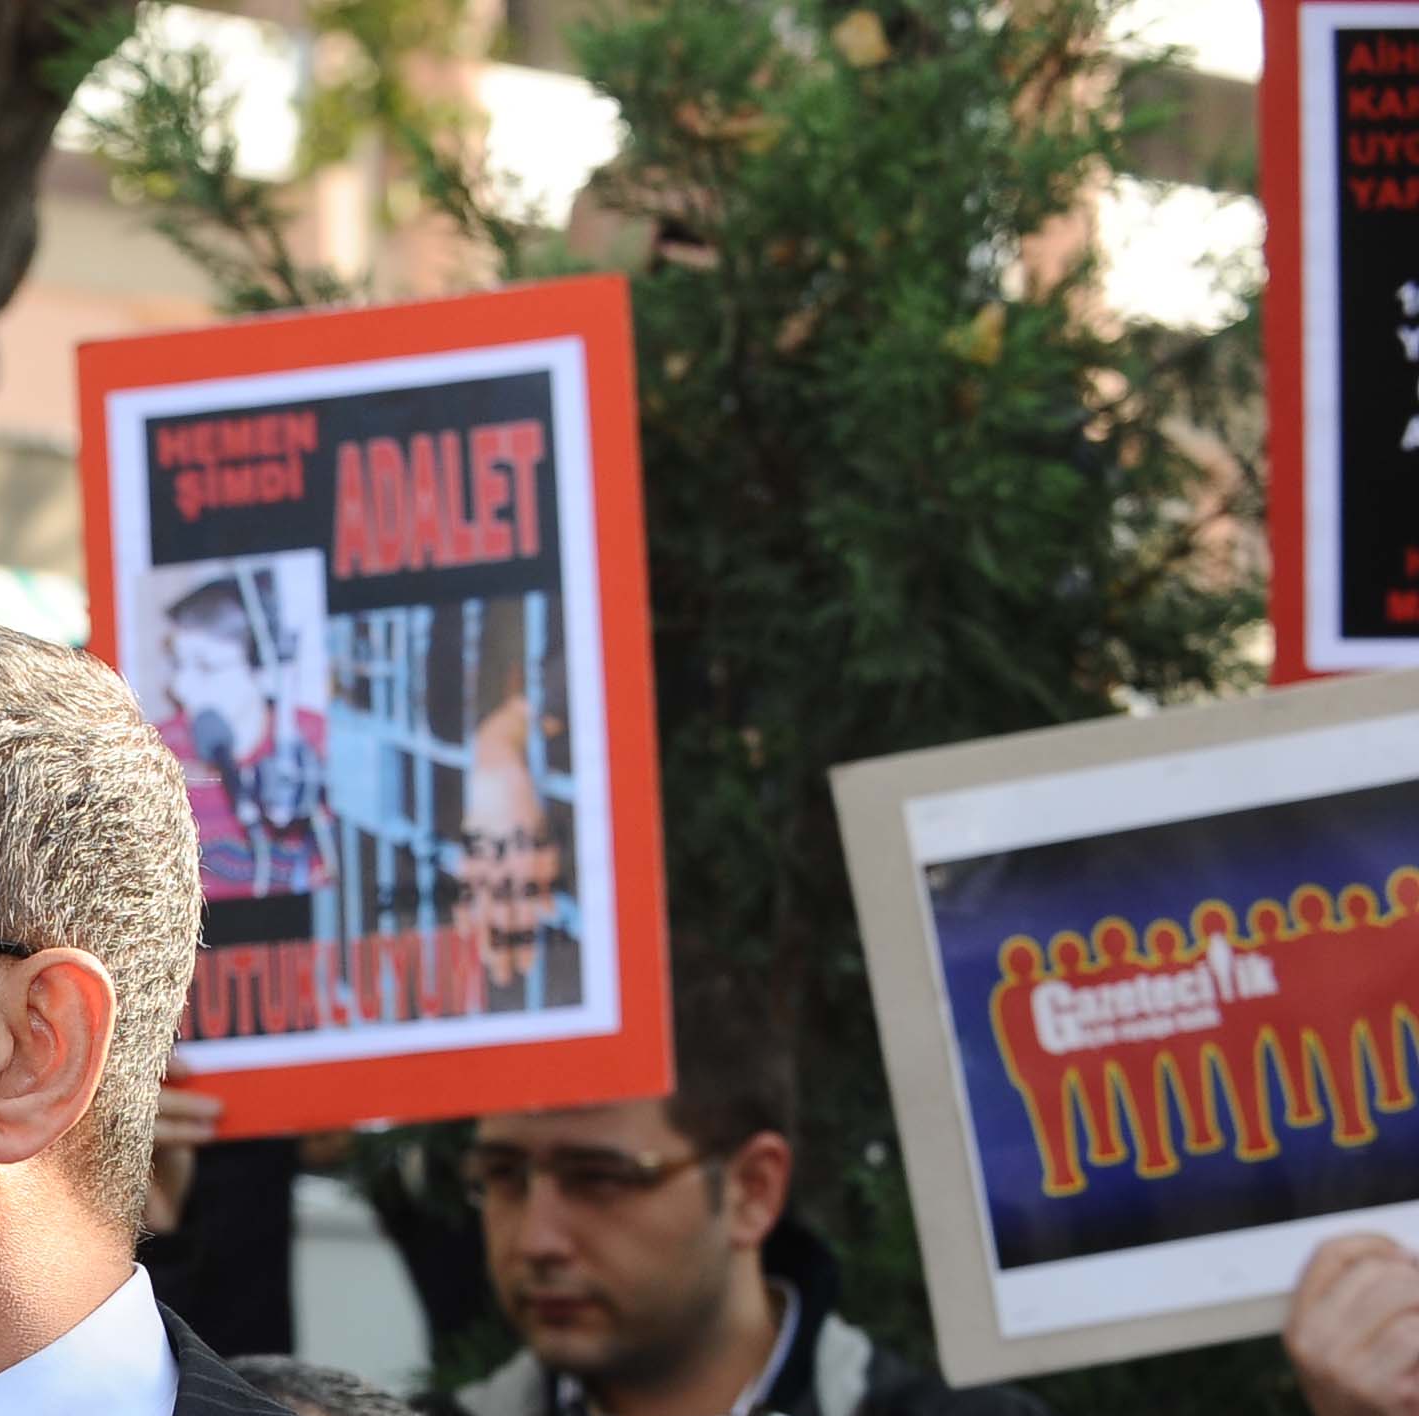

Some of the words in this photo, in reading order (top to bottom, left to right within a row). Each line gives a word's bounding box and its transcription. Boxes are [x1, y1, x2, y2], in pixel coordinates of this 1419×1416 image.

[155, 410, 317, 468] HEMEN
[174, 451, 304, 523] ŞİMDİ
[333, 419, 545, 580] ADALET
